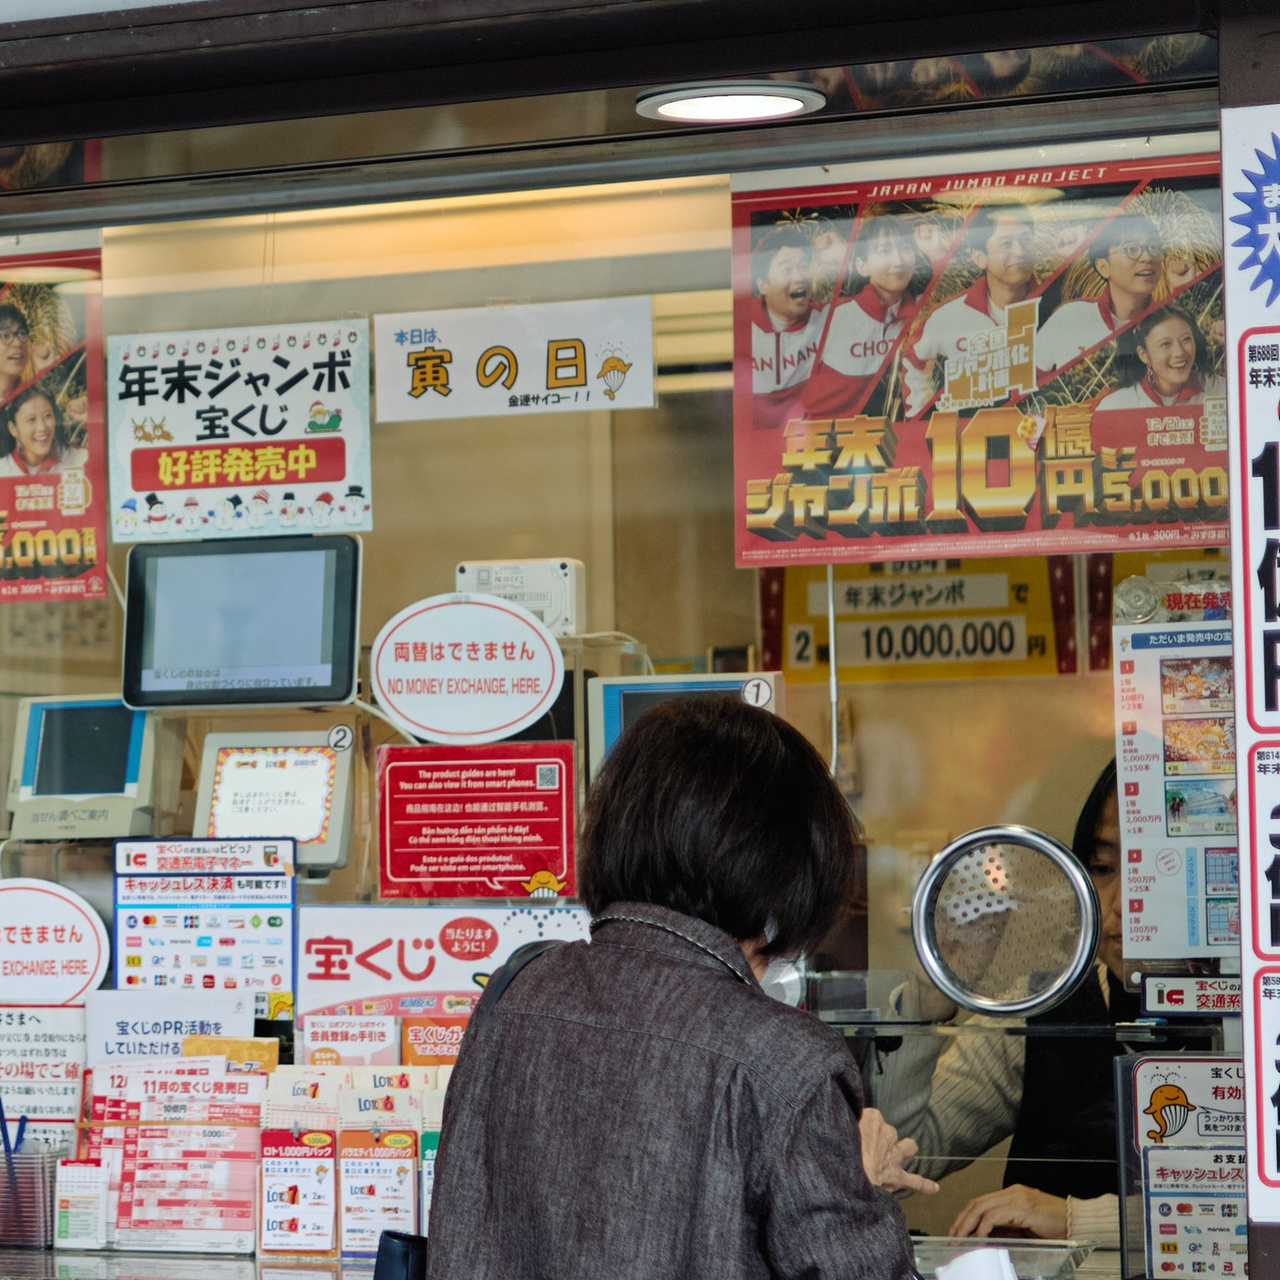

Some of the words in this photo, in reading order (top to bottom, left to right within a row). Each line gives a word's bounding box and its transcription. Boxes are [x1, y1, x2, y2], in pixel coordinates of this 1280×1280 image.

[866, 181, 933, 198] JAPAN
[939, 175, 1007, 192] JUMBO
[1013, 167, 1108, 185] PROJECT
[394, 328, 444, 347] 本日は、
[406, 338, 590, 399] 寅の日
[118, 349, 353, 406] 年末ジャンボ
[195, 403, 288, 442] 宝くじ
[782, 414, 894, 472] 年末
[158, 445, 318, 487] 好評発売中
[746, 467, 922, 531] ジャンボ
[845, 580, 965, 608] 年末ジャンボ
[795, 631, 811, 662] 2
[861, 621, 1015, 660] 10,000,000
[1027, 635, 1046, 657] 円
[393, 640, 536, 662] 両替はできません
[387, 679, 403, 695] NO
[405, 678, 444, 695] MONEY
[446, 677, 509, 697] EXCHANGE,
[511, 677, 544, 694] HERE.
[418, 770, 432, 779] The
[433, 769, 461, 780] product
[461, 769, 485, 780] guides
[485, 770, 497, 778] are
[497, 768, 517, 778] here!
[400, 782, 412, 790] You
[429, 781, 443, 790] also
[444, 781, 460, 789] view
[468, 780, 485, 789] from
[485, 780, 507, 789] smart
[507, 779, 536, 790] phones.
[522, 835, 544, 843] minh.
[157, 856, 253, 870] 交通系電子マネー
[410, 864, 426, 872] Pode
[481, 862, 526, 873] smartphone.
[422, 856, 436, 864] Este
[465, 855, 478, 863] dos
[478, 854, 513, 865] produtos!
[124, 877, 235, 893] キャッシュレス決済
[444, 926, 493, 941] 当たります
[450, 939, 486, 954] ように!
[304, 935, 437, 982] 宝くじ
[1, 960, 59, 979] EXCHANGE,
[60, 960, 91, 976] HERE.
[1262, 975, 1280, 987] 第59
[399, 996, 437, 1008] NUMBERS
[1196, 993, 1241, 1010] 交通系
[115, 1020, 223, 1036] 宝くじのPR活動を
[310, 1030, 387, 1042] 会員登録の手引き
[104, 1040, 181, 1056] していただける
[143, 1080, 249, 1095] 11月の宝くじ発売日
[1211, 1085, 1245, 1100] 有効
[1156, 1166, 1244, 1182] キャッシュレス
